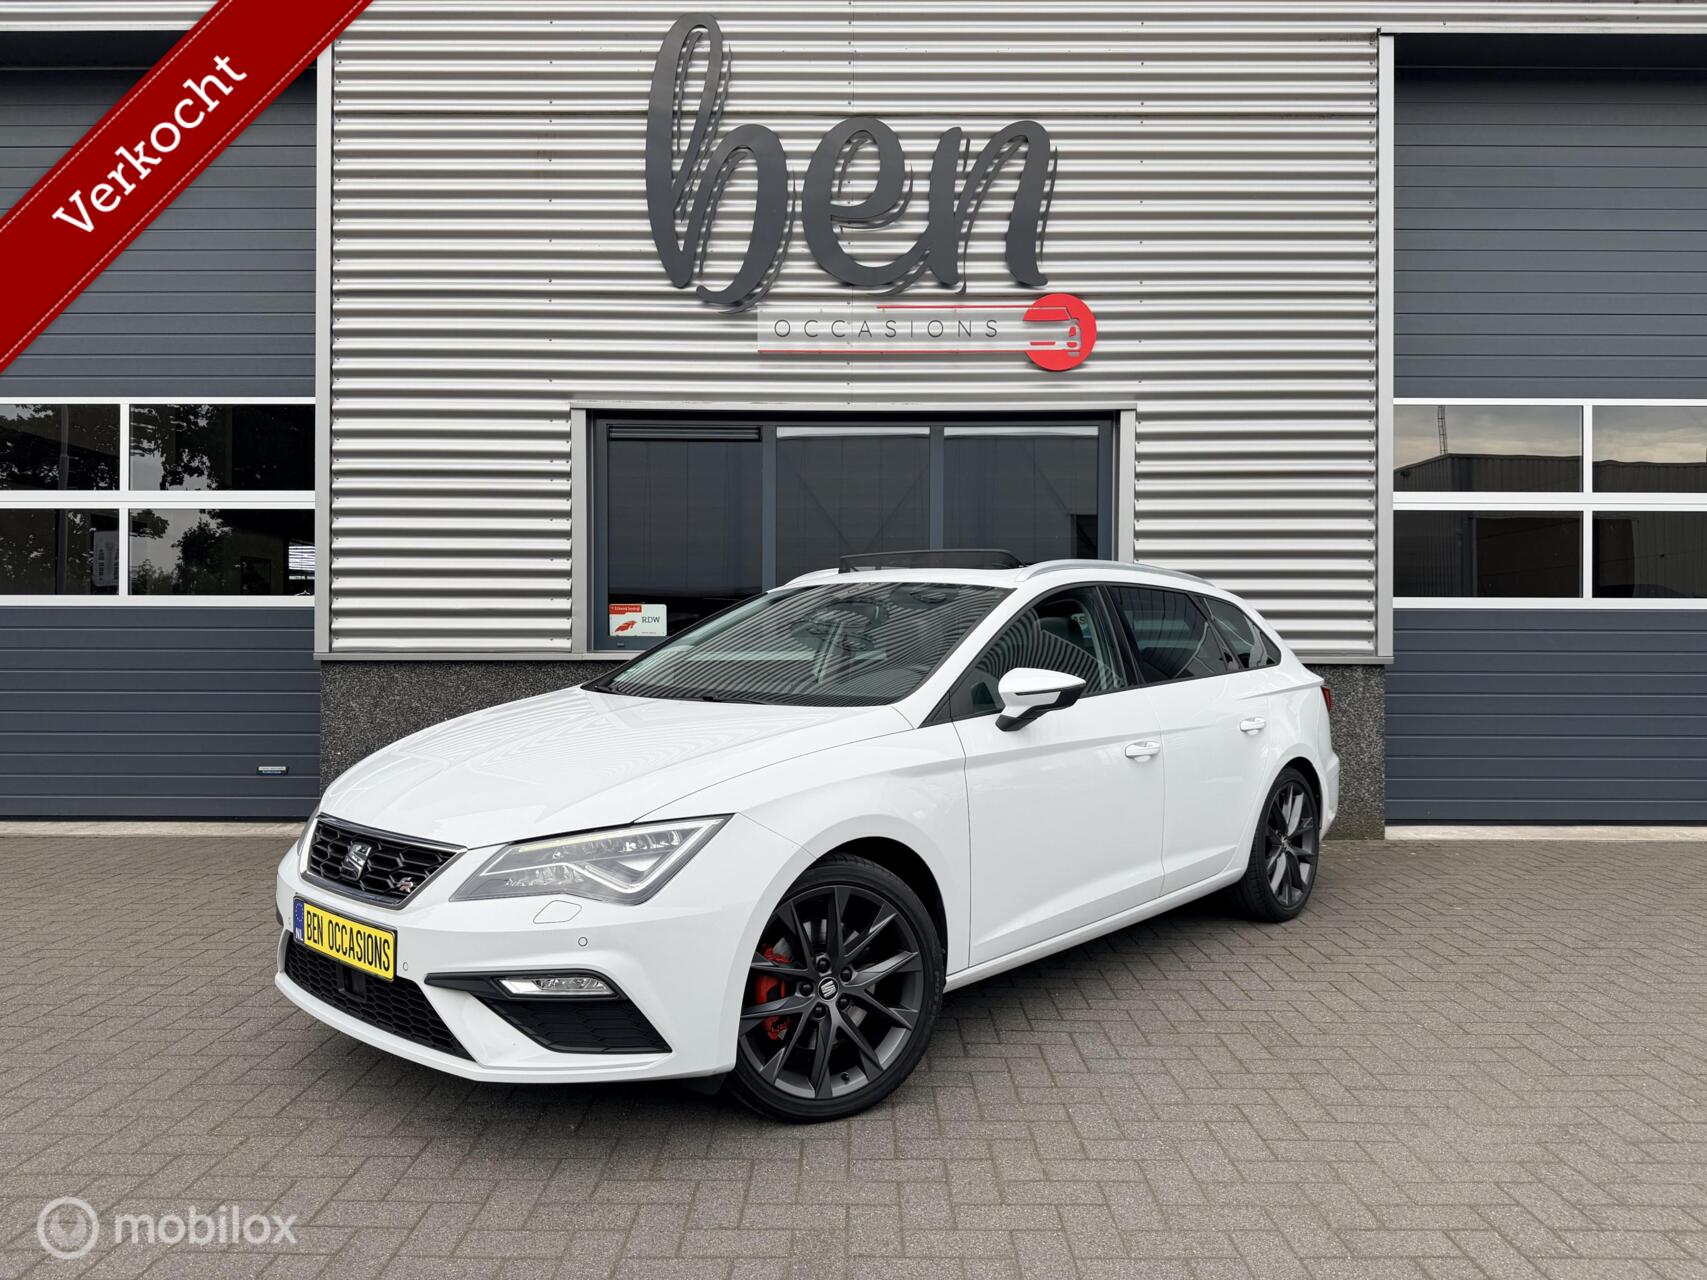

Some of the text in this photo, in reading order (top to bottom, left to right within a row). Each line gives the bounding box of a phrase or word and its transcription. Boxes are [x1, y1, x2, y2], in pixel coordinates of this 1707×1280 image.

[645, 13, 1050, 304] ben
[773, 318, 1001, 339] OCCASIONS
[641, 616, 660, 624] RDW
[295, 927, 304, 941] NL
[306, 910, 391, 972] BEN OCCASIONS
